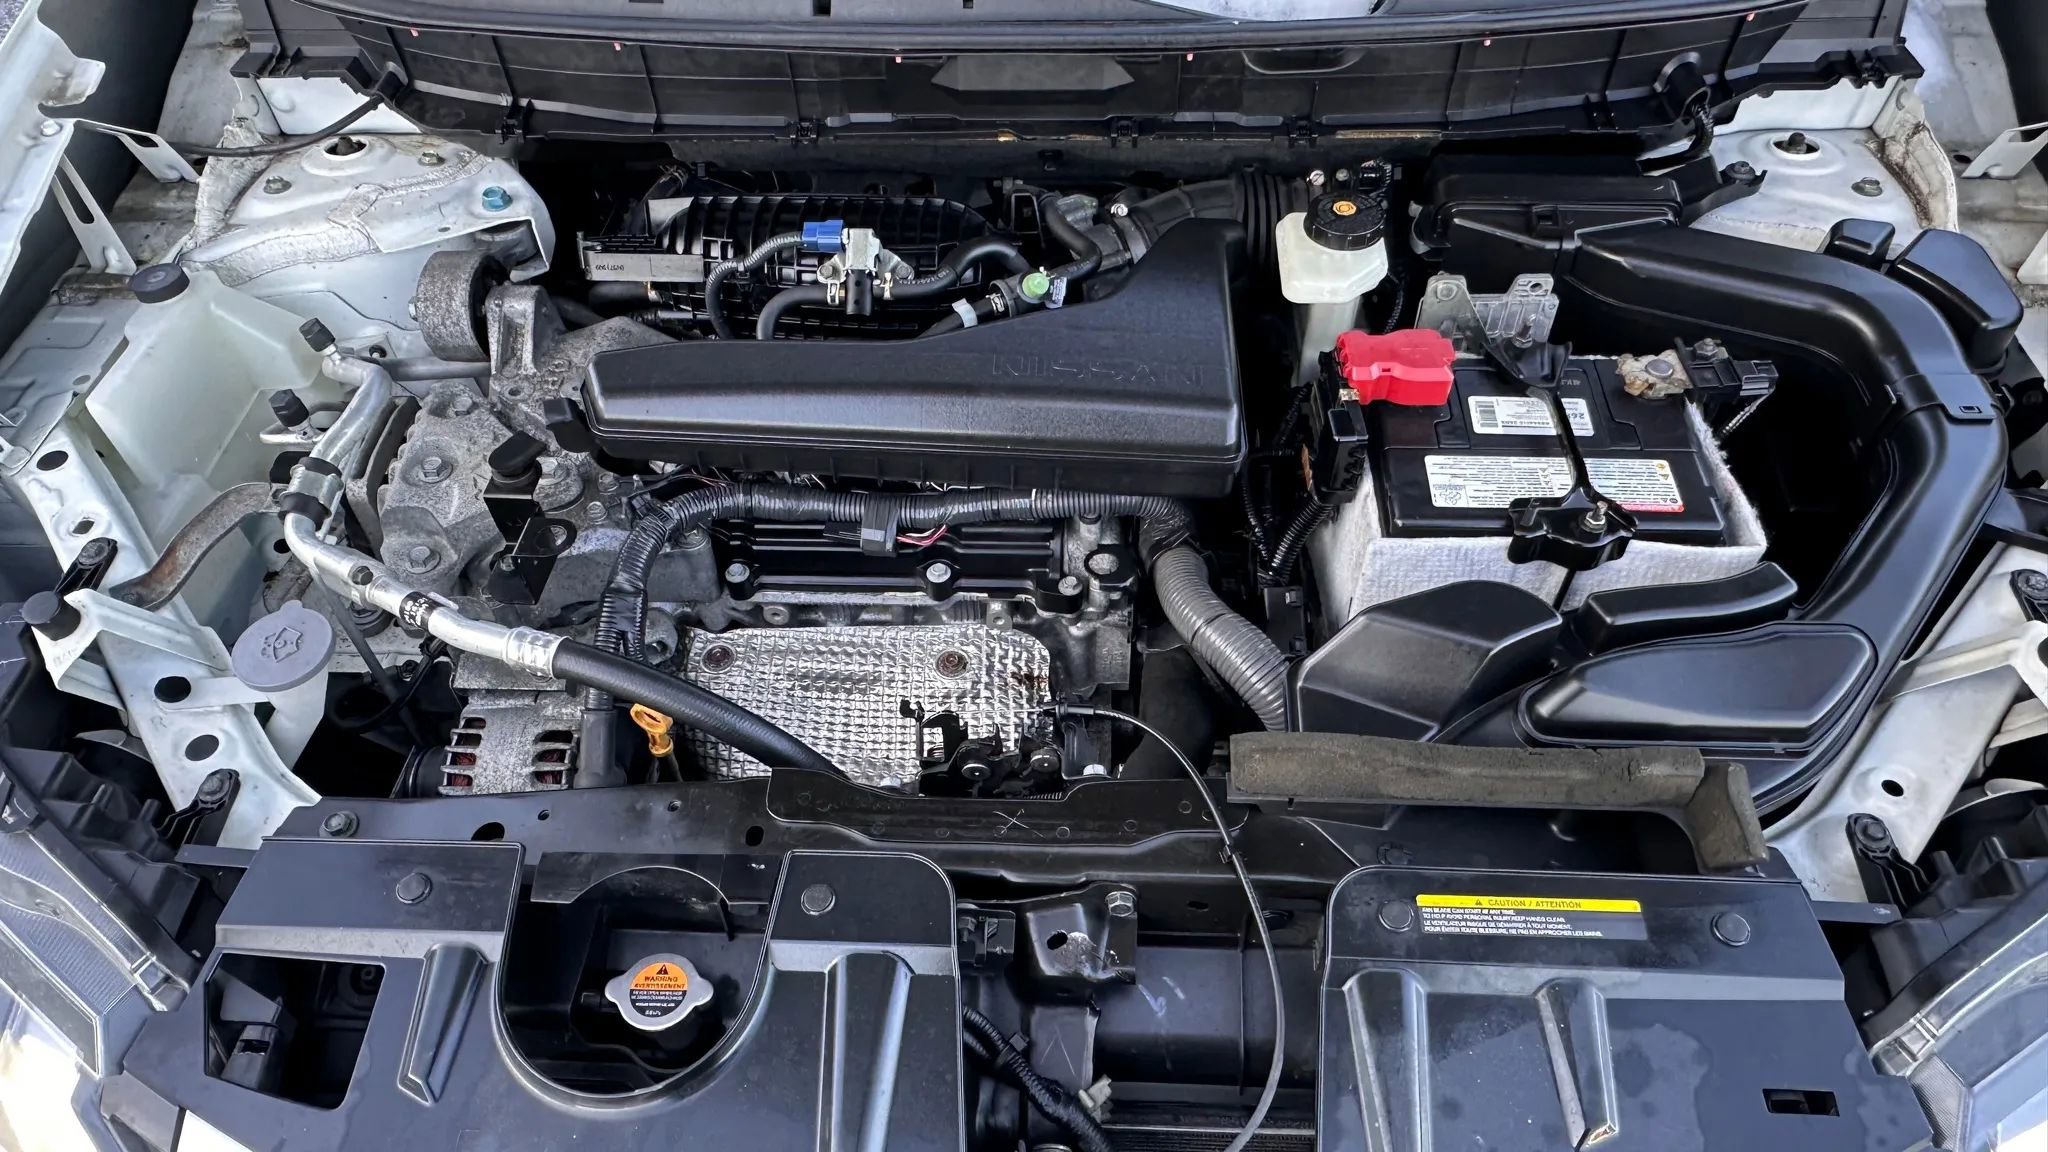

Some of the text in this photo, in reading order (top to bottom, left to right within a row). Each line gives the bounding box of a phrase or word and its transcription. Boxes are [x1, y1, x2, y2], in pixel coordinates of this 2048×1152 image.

[991, 353, 1207, 386] NISSAN
[1488, 899, 1526, 907] CAUTION
[1535, 900, 1582, 908] ATTENTION
